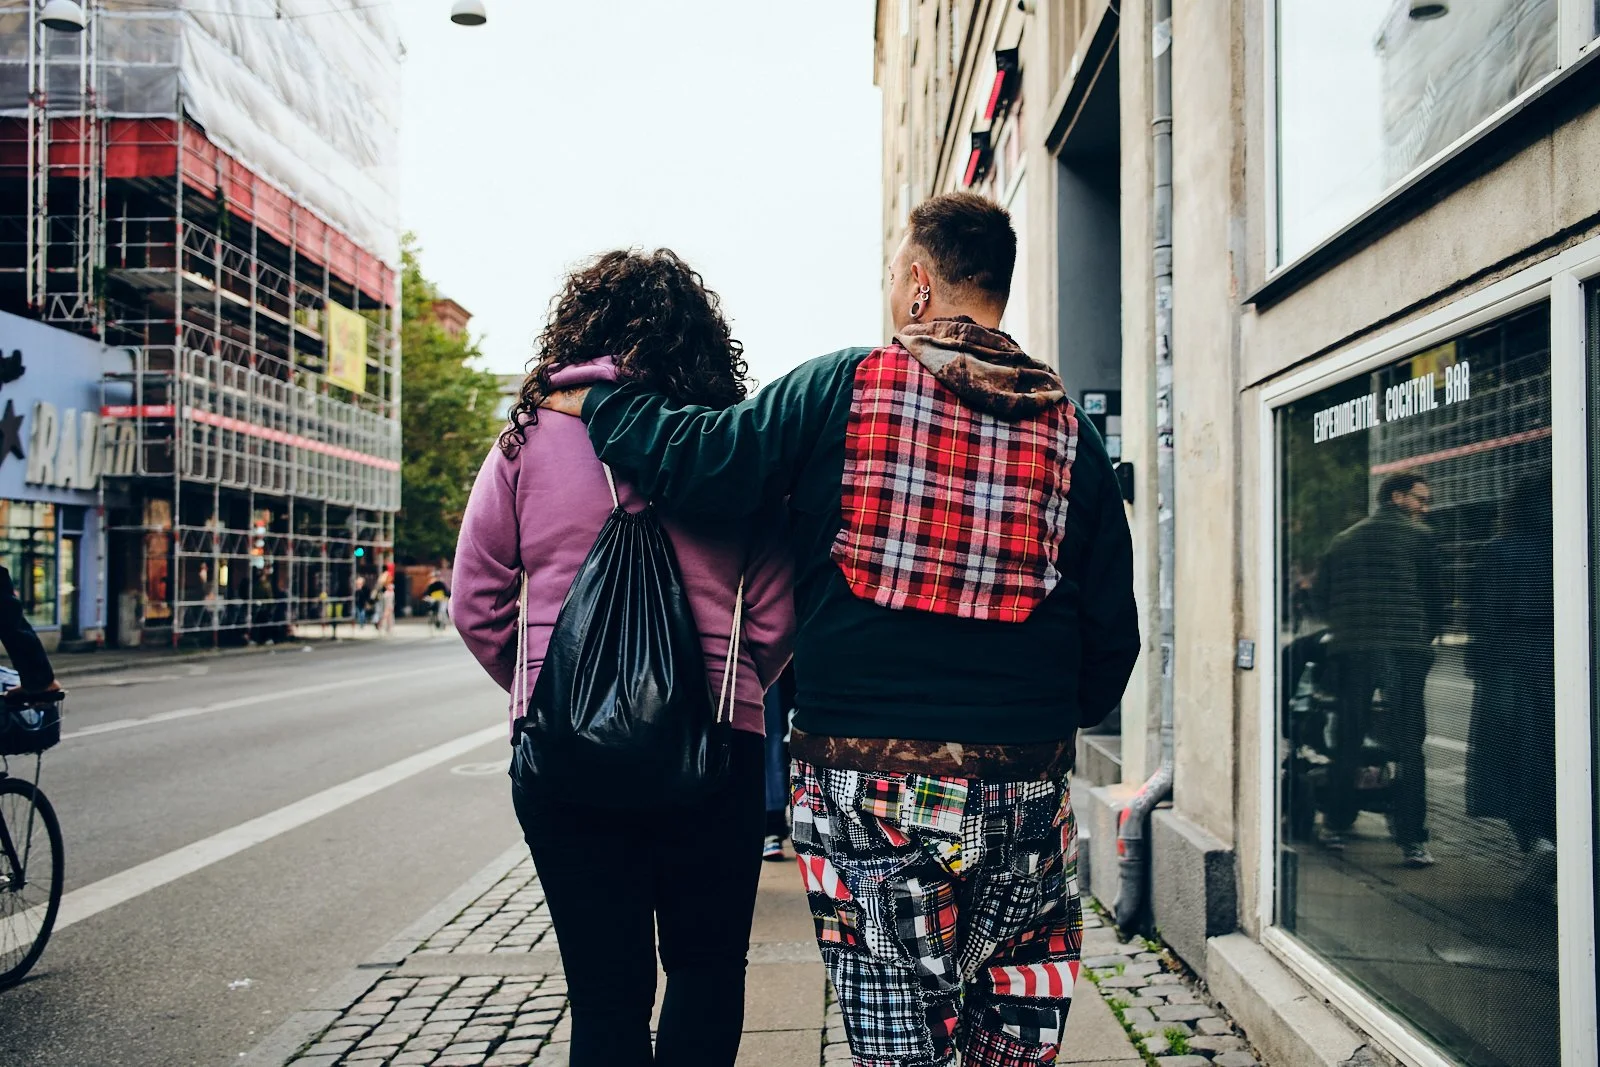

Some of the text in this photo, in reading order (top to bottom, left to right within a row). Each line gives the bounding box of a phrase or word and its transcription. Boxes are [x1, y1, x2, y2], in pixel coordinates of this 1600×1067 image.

[1314, 361, 1470, 443] EXPERIMENTAL COCKTAIL BAR
